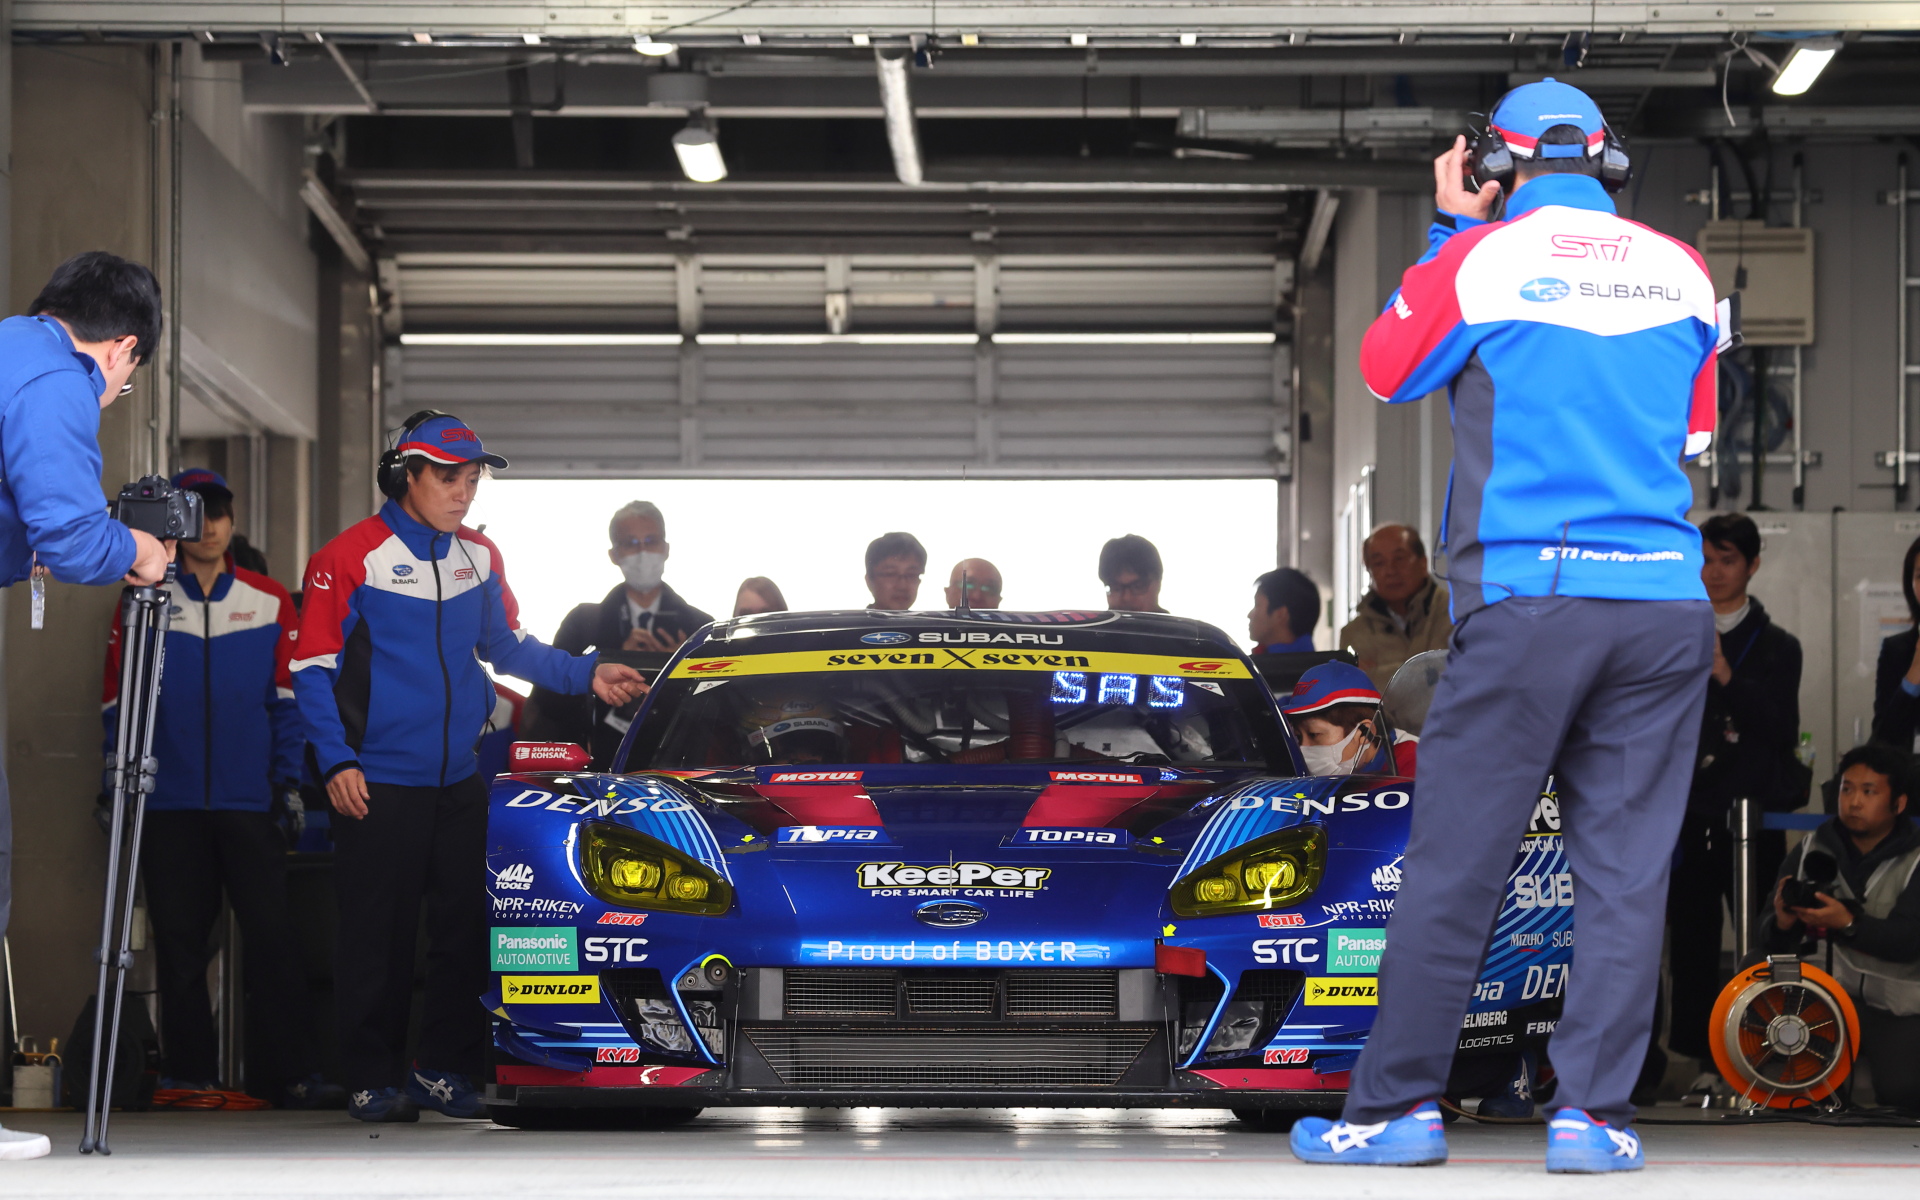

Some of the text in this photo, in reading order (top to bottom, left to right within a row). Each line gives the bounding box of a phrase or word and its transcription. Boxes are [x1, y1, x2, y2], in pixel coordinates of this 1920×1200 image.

[1579, 282, 1681, 302] SUBARU
[1538, 546, 1684, 562] STI Performance
[918, 632, 1064, 645] SUBARU
[826, 652, 934, 666] seven
[982, 653, 1091, 668] seven
[792, 720, 829, 728] SUBARU
[774, 772, 857, 782] MOTUL
[1055, 772, 1139, 782] MOTUL
[504, 790, 695, 817] DENSO
[1231, 791, 1410, 816] DENSO
[495, 863, 534, 882] MAC
[861, 863, 1047, 888] KeePer
[495, 881, 532, 891] TOOLS
[871, 889, 1034, 898] FOR SMART CAR LIFE
[1373, 884, 1400, 892] TOO
[492, 897, 585, 914] NPR-RIKEN
[494, 912, 574, 920] Corporation
[498, 934, 568, 949] Panasonic
[1510, 931, 1575, 948] MIZUHO SUB
[584, 937, 649, 962] STC
[828, 940, 1076, 961] Proud of BOXER
[1252, 938, 1320, 963] STC
[497, 953, 571, 965] AUTOMOTIVE
[520, 984, 593, 995] DUNLOP
[1326, 986, 1378, 997] DUNL
[1461, 1010, 1508, 1029] ELNBERG
[1458, 1034, 1515, 1049] LOGISTICS
[596, 1047, 641, 1063] KYB
[1264, 1048, 1310, 1065] KYB
